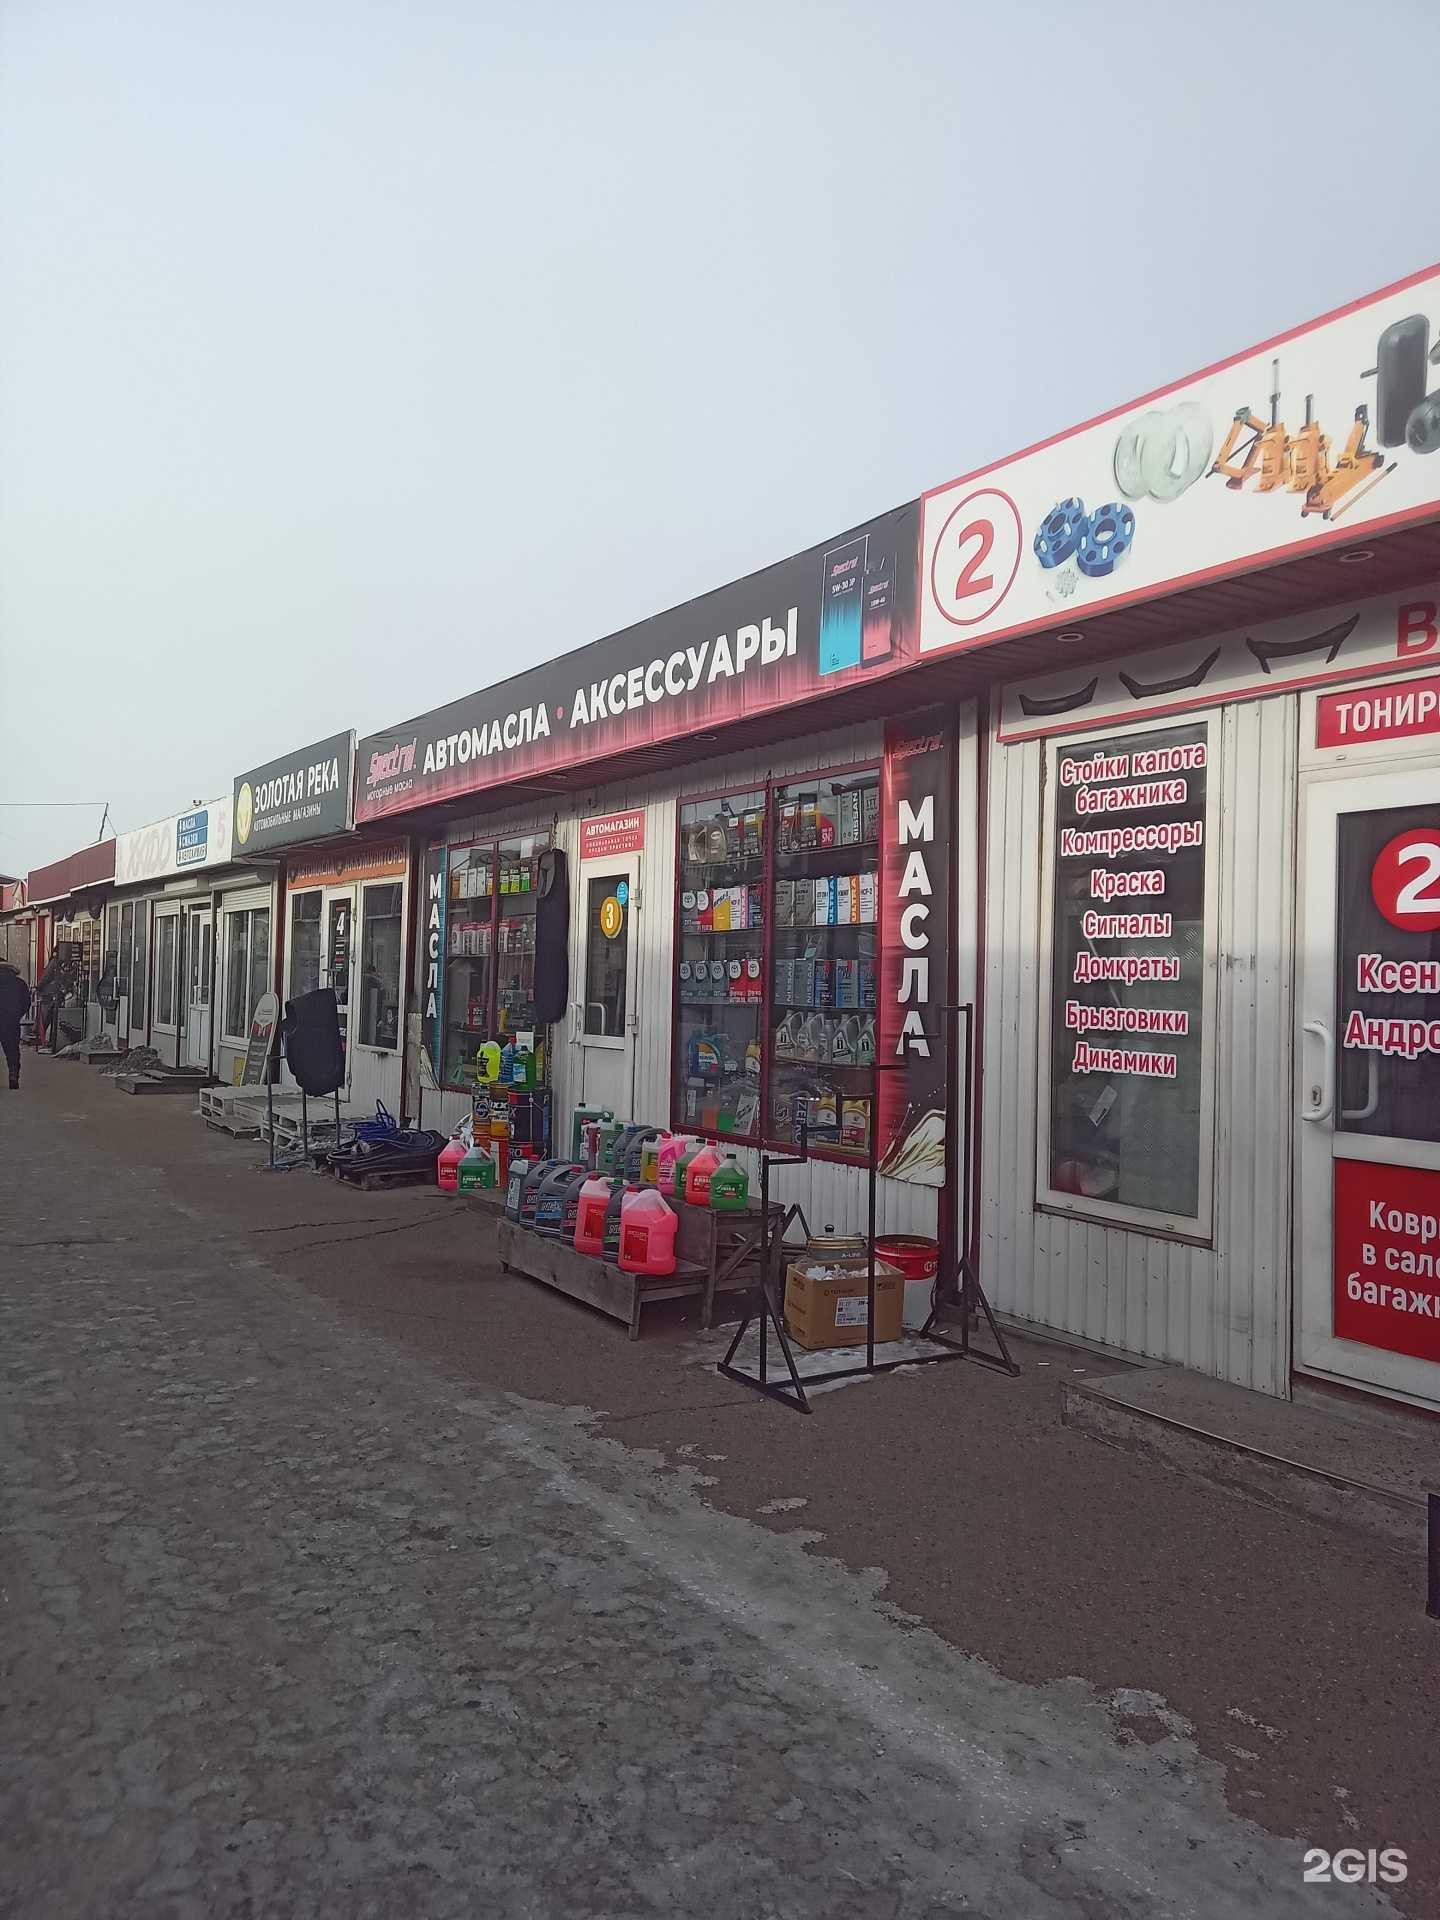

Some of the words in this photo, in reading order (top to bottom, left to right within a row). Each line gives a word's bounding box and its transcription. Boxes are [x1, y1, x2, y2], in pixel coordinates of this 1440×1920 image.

[955, 517, 996, 602] 2
[423, 702, 550, 775] АВТОМАСЛА
[570, 606, 799, 730] АКСЕССУАРЫ
[1335, 689, 1440, 735] ТОНИР
[1061, 752, 1129, 787] Стойки
[1132, 743, 1207, 777] капота
[254, 769, 304, 815] ЗОЛОТАЯ
[307, 757, 339, 799] РЕКА
[1076, 778, 1187, 815] багажника
[585, 817, 640, 837] АВТОМАГАЗИН
[1061, 821, 1202, 858] Компрессоры
[1091, 868, 1165, 902] Краска
[1396, 842, 1440, 914] 2
[336, 911, 345, 936] 4
[606, 903, 614, 929] 3
[897, 795, 934, 1057] МАСЛА
[1083, 910, 1172, 940] Сигналы
[426, 873, 442, 1018] МАСЛА
[1074, 951, 1180, 986] Домкраты
[1066, 1000, 1189, 1036] Брызговики
[1072, 1040, 1177, 1078] Динамики
[1369, 1200, 1440, 1244] Ковр
[1362, 1243, 1377, 1266] в
